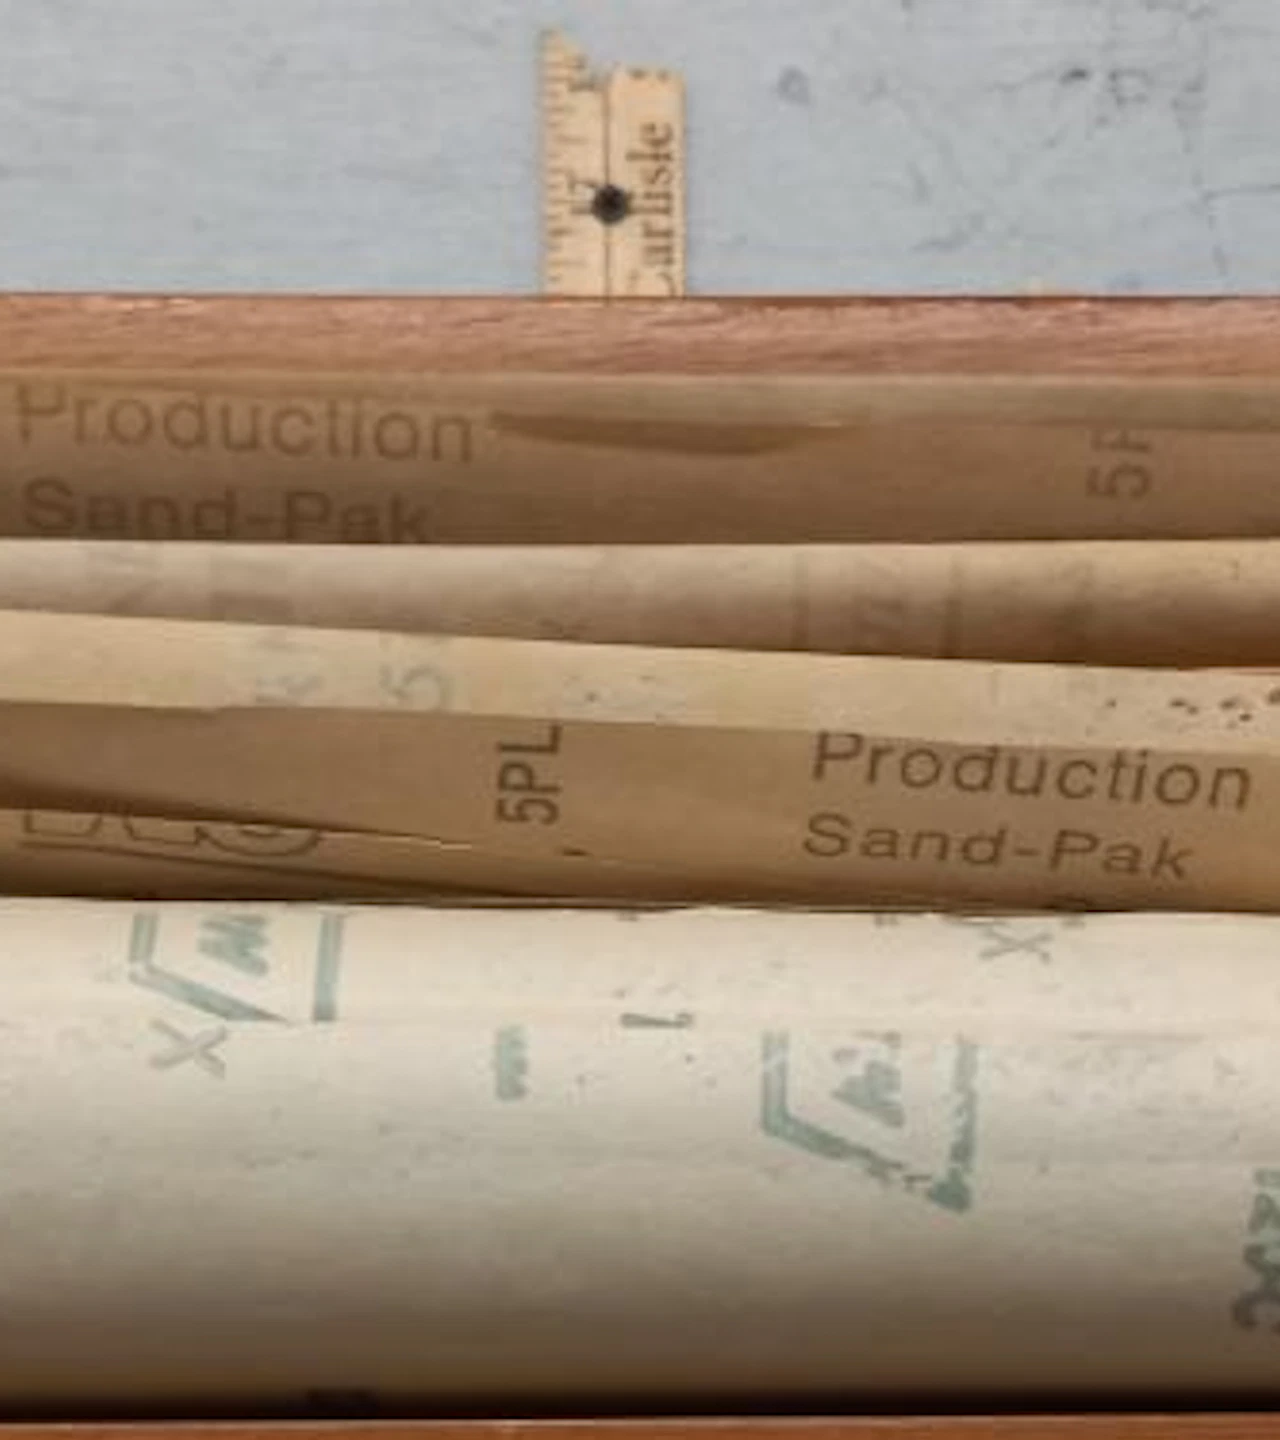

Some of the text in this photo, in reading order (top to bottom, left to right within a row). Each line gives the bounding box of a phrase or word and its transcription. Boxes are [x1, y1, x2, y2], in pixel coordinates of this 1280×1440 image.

[17, 380, 475, 464] Production
[494, 723, 563, 827] 5PL
[810, 730, 1254, 812] Production
[801, 811, 1195, 880] Sand-Pak
